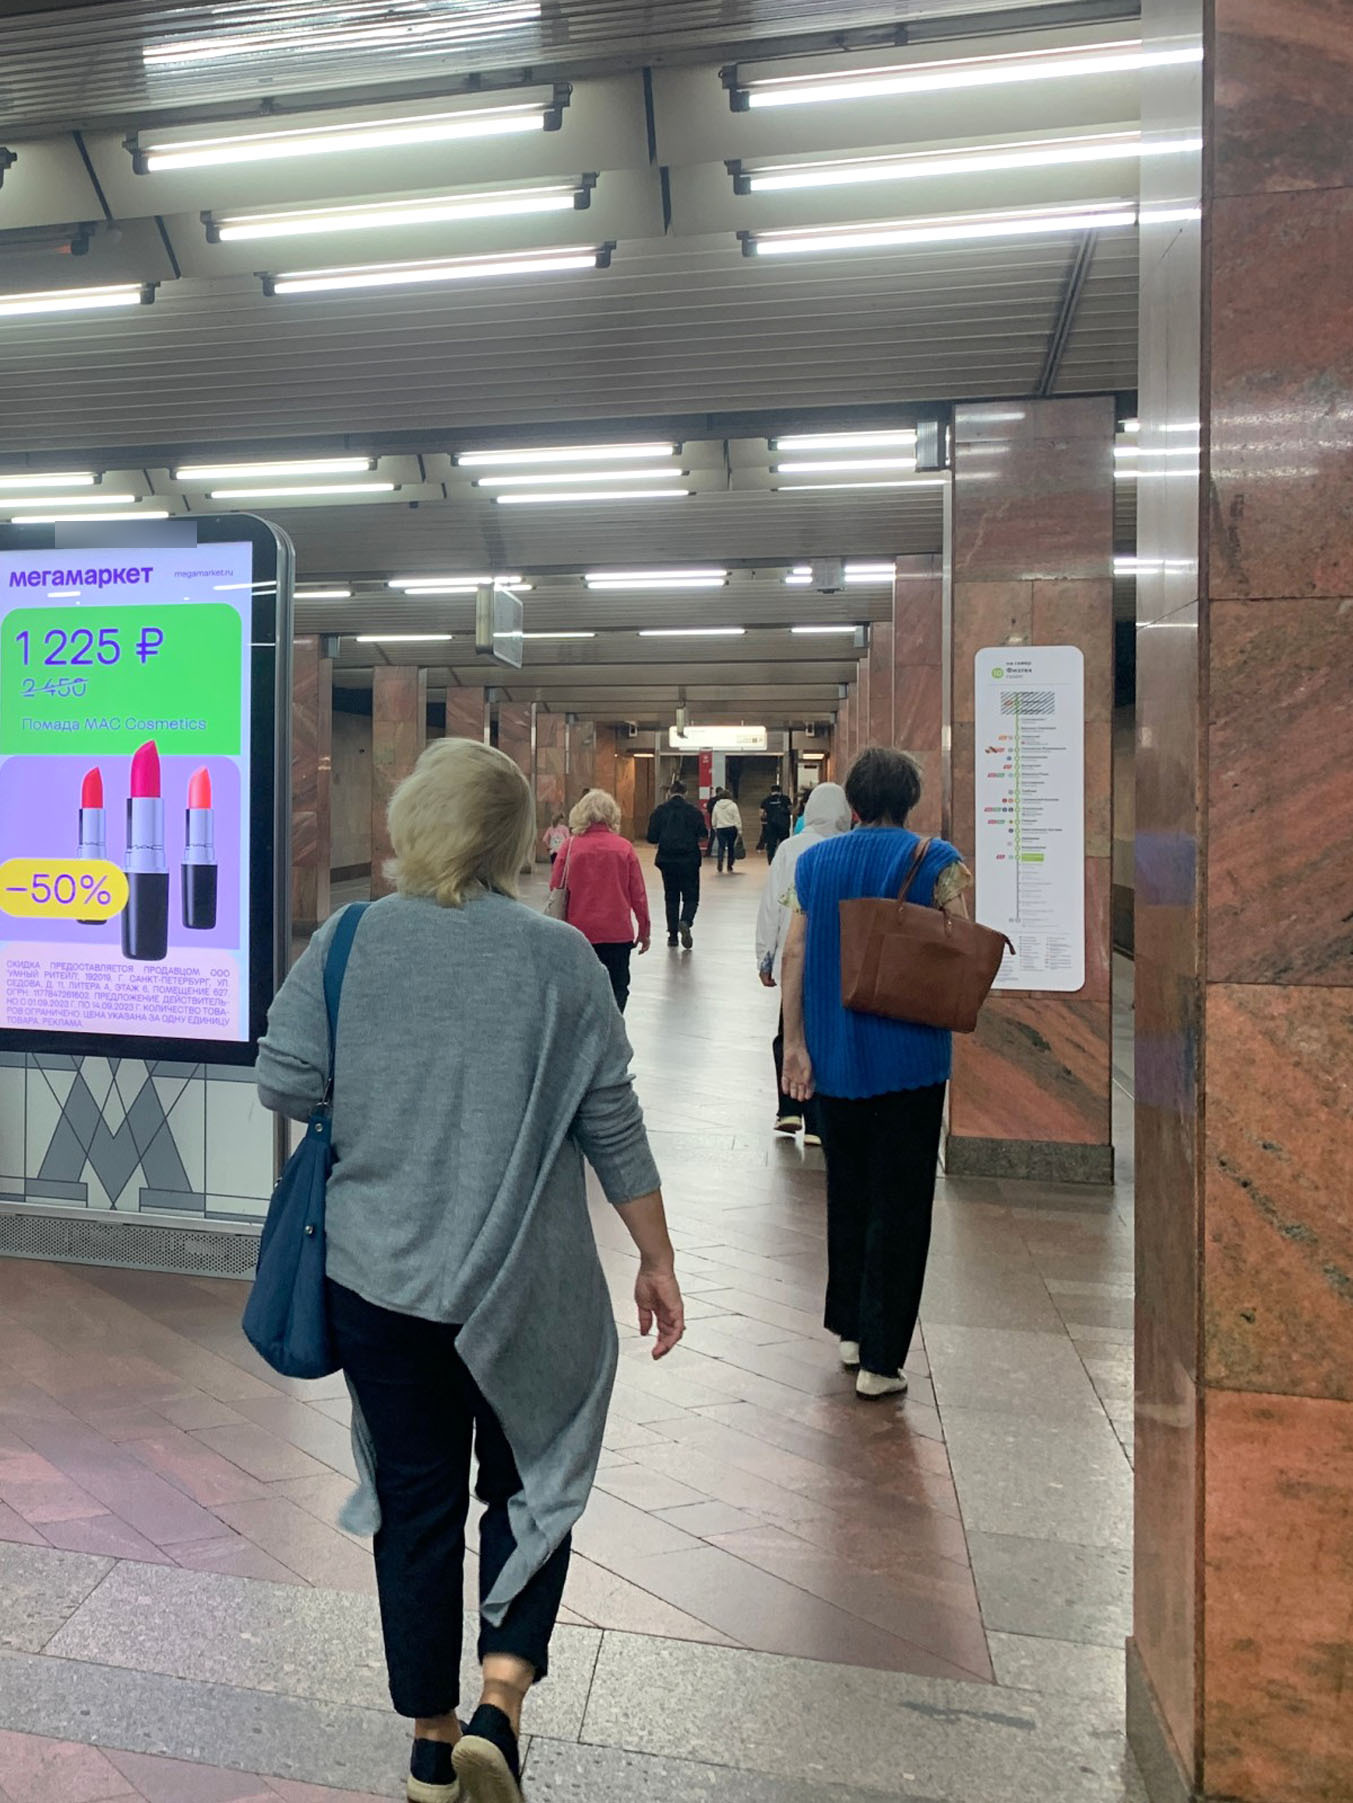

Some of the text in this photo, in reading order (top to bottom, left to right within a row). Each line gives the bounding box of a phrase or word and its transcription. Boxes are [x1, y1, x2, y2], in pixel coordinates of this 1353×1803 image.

[9, 567, 154, 588] мегамаркет
[174, 569, 234, 578] megamarket.ru
[15, 631, 30, 666] 1
[43, 628, 121, 666] 225
[21, 678, 87, 697] 2 450
[22, 716, 207, 732] Помада MAC Cosmetics
[6, 960, 40, 969] СКИДКА
